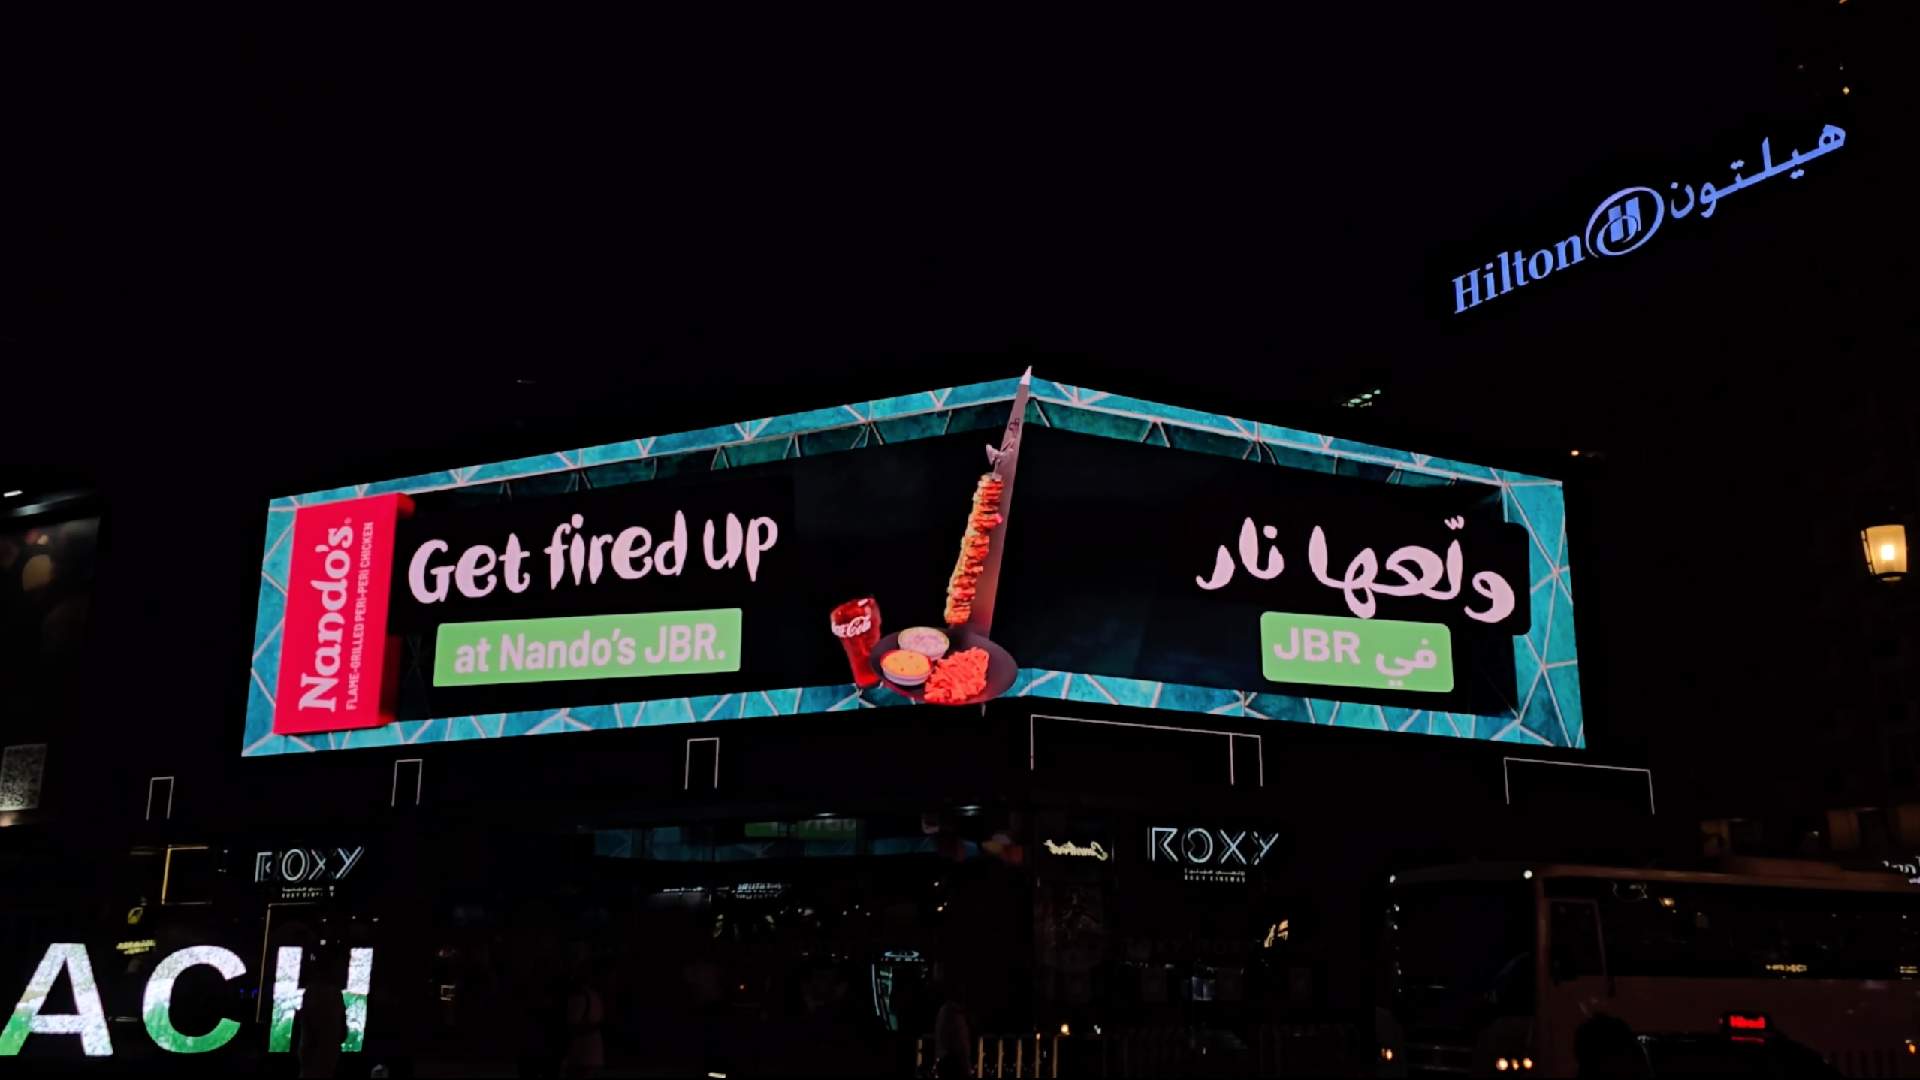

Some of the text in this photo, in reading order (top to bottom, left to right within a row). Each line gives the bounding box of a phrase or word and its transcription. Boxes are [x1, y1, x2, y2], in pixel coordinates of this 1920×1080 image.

[1670, 124, 1846, 219] هيلتون
[1452, 234, 1586, 314] Hilton
[360, 521, 375, 569] CHICKEN
[408, 510, 778, 604] Get fired up
[1196, 516, 1285, 590] نار
[454, 622, 727, 674] at Nando's JBR.
[1273, 627, 1437, 688] في JBR
[1147, 826, 1280, 866] ROXY
